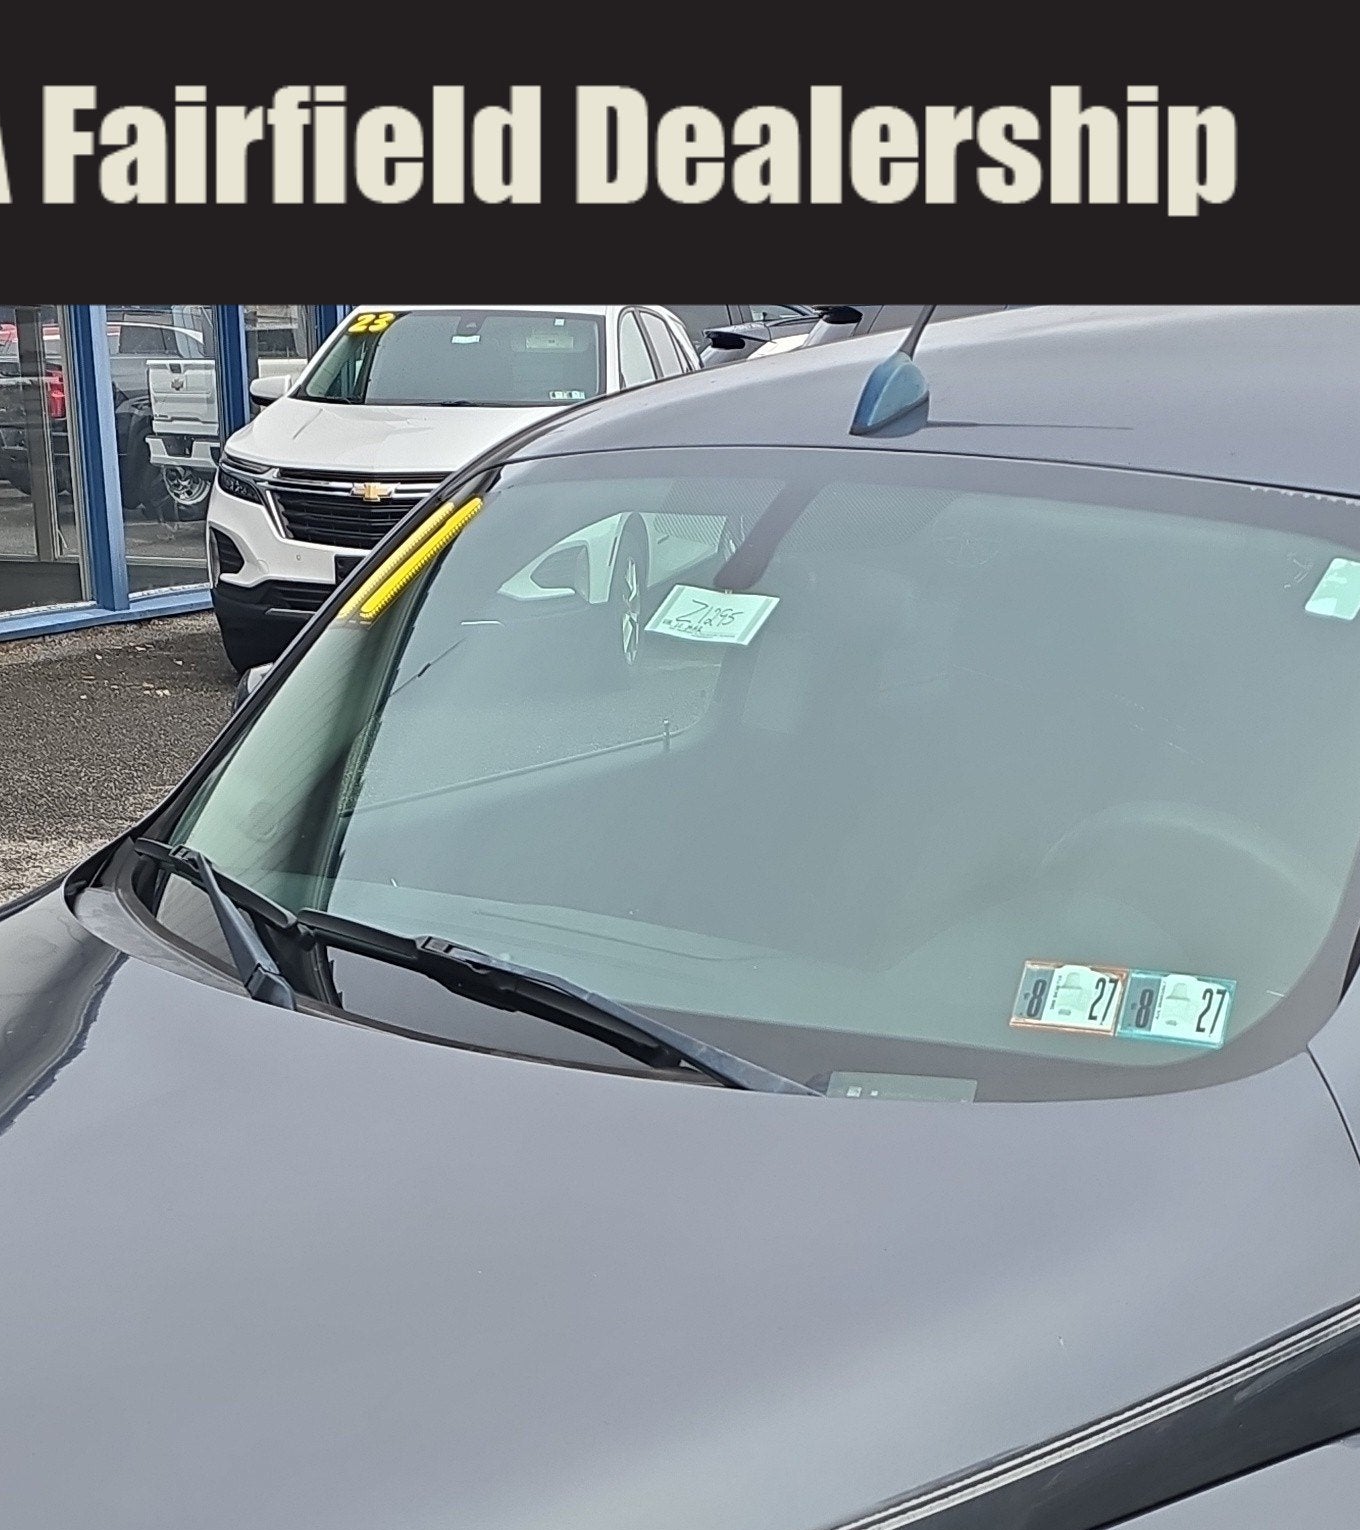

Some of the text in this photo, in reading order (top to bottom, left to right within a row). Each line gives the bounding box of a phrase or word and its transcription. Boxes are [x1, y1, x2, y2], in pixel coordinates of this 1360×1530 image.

[347, 312, 396, 333] 23
[1087, 977, 1120, 1022] 27
[1195, 987, 1228, 1034] 27
